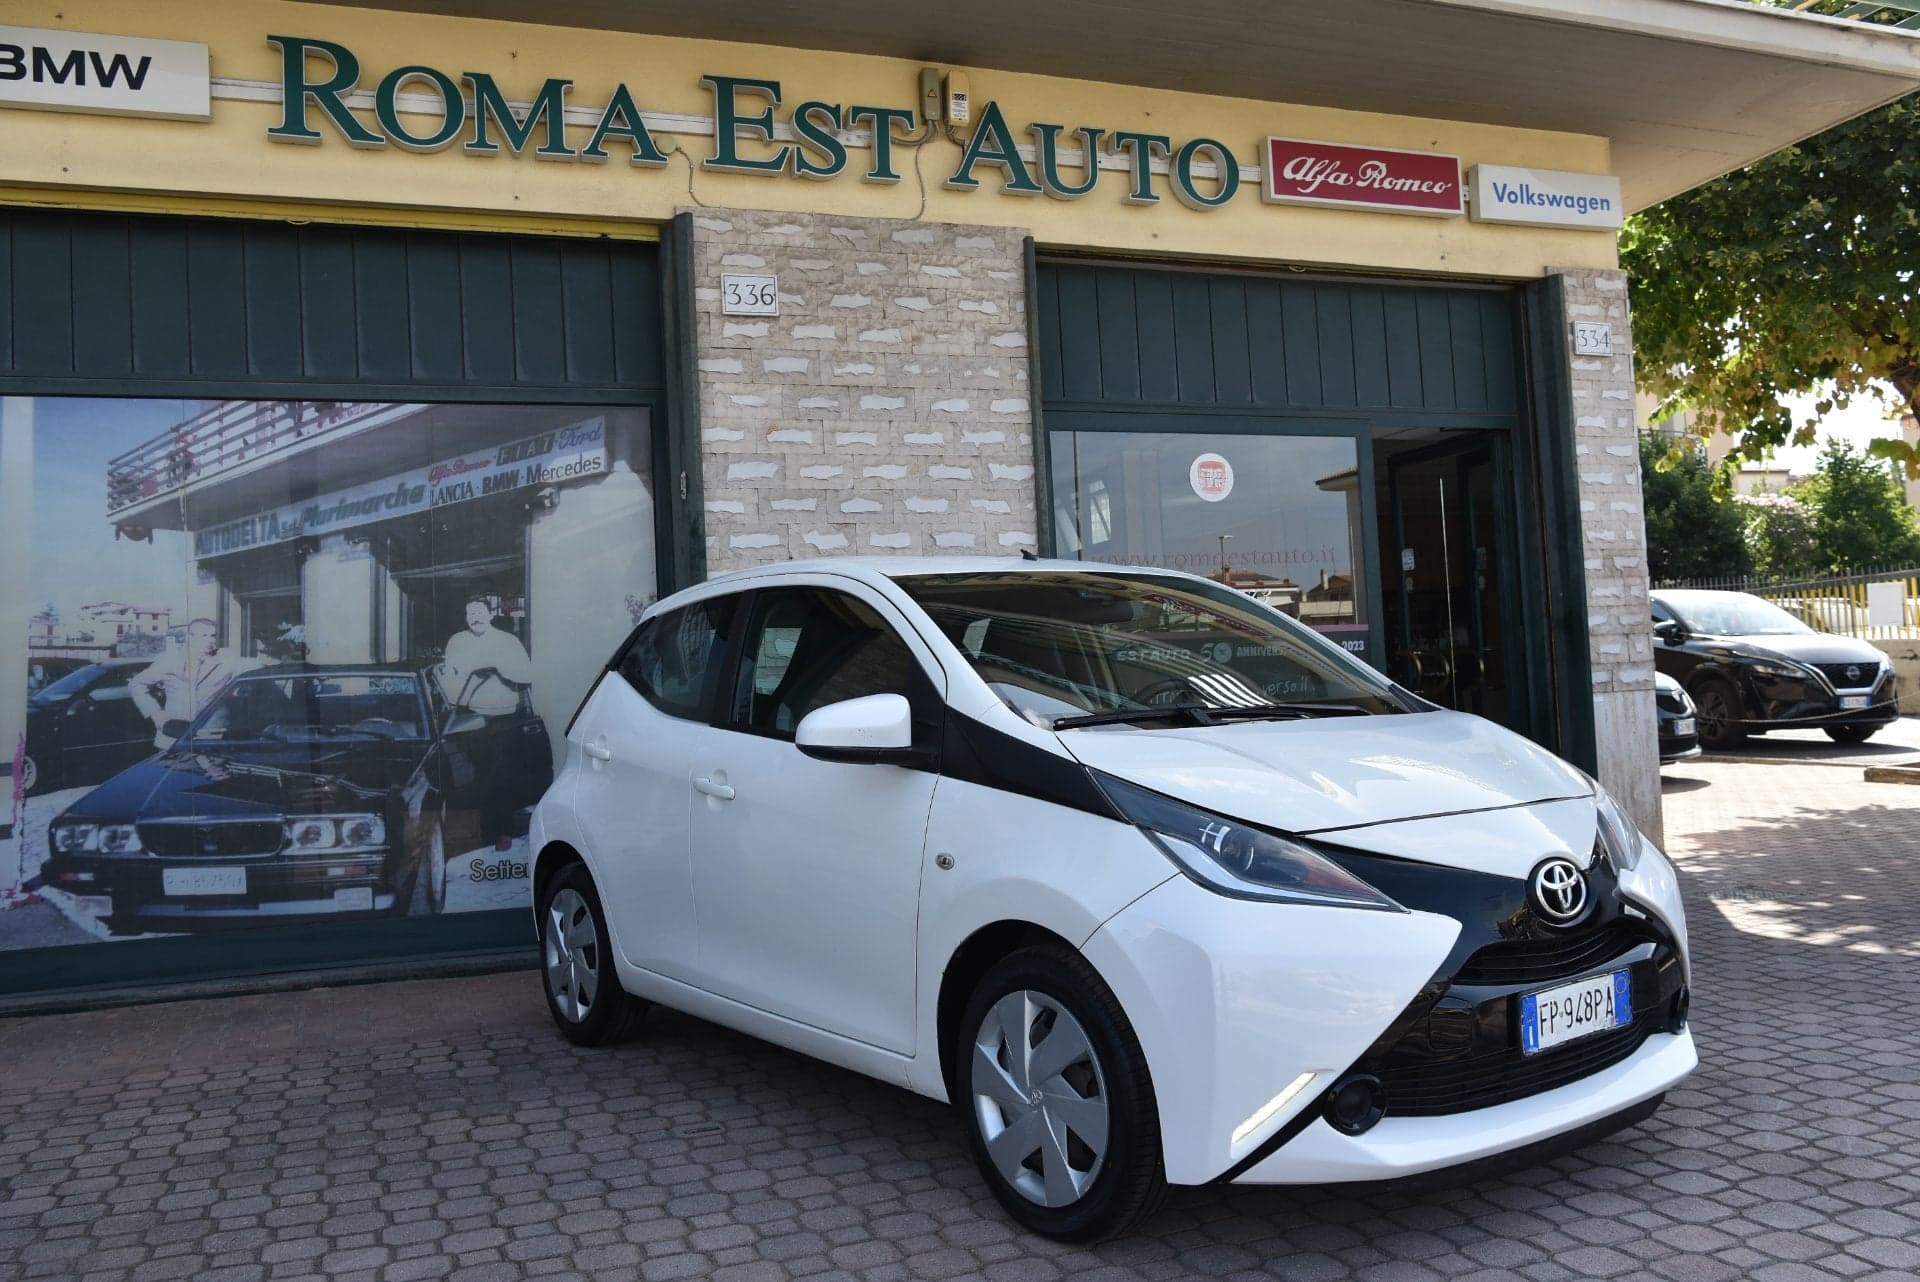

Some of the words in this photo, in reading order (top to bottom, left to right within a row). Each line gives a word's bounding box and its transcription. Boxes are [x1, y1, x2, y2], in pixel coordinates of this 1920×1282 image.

[0, 44, 152, 91] BMW
[266, 35, 669, 168] ROMA
[702, 74, 915, 184] EST
[943, 100, 1241, 210] AUTO
[1282, 156, 1354, 194] Alfa
[1355, 160, 1455, 194] Romeo
[1492, 182, 1611, 214] Volkswagen
[727, 283, 774, 306] 336
[1577, 329, 1611, 350] 334
[500, 436, 553, 463] FIAT
[557, 421, 603, 449] Ford
[430, 480, 475, 507] LANCIA
[482, 468, 520, 494] BMW
[526, 453, 601, 485] Mercedes
[1341, 640, 1365, 651] 2023
